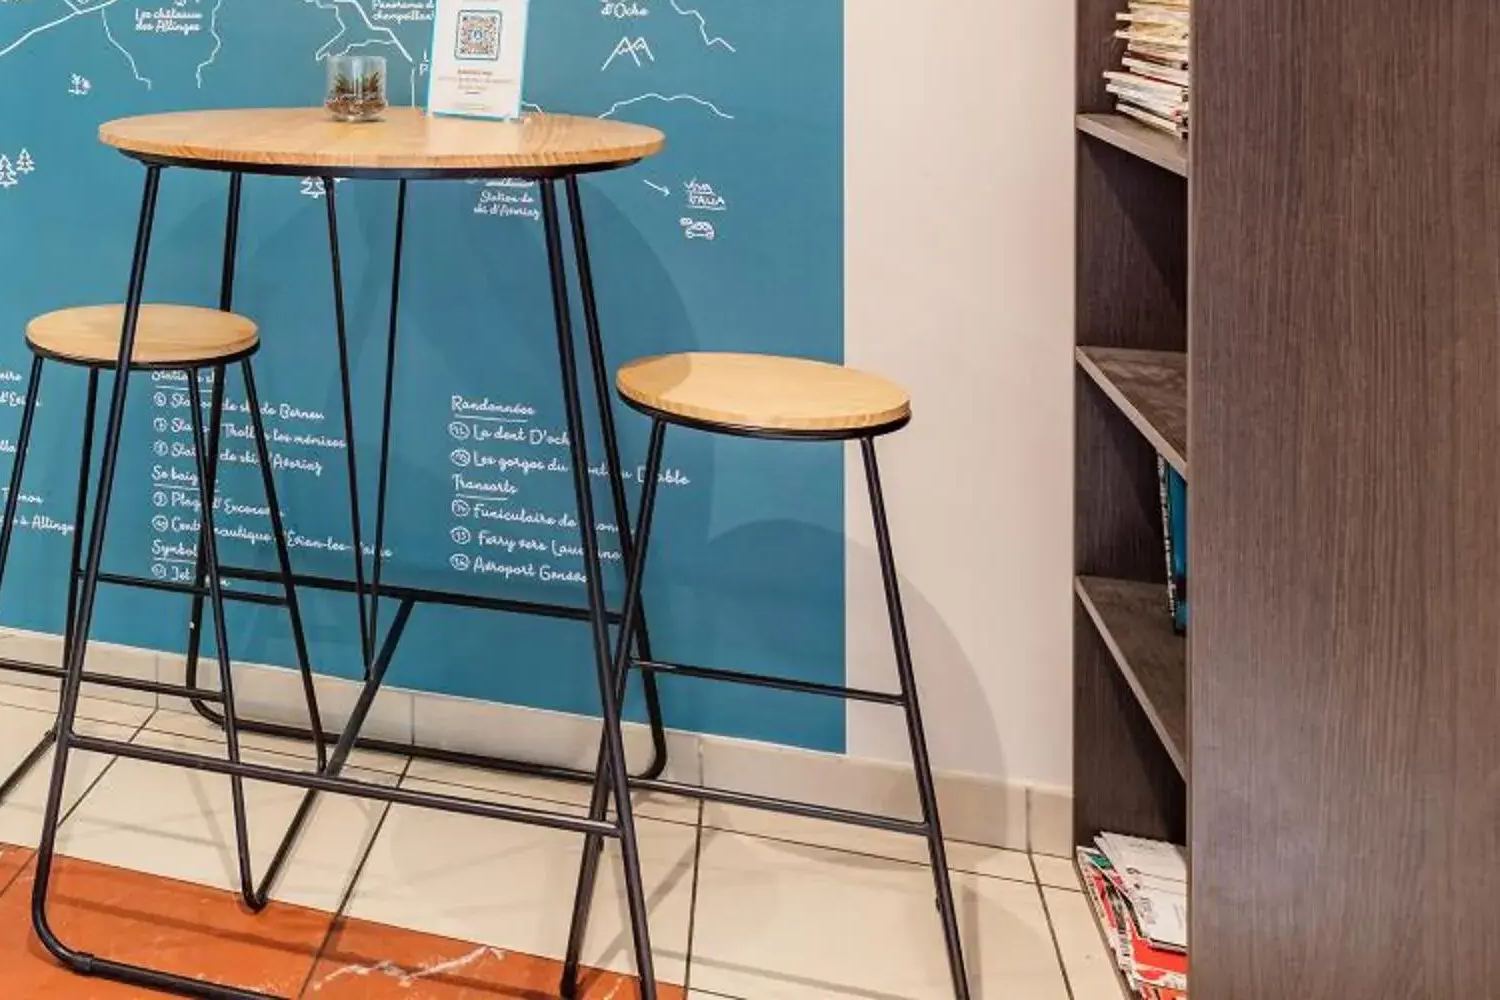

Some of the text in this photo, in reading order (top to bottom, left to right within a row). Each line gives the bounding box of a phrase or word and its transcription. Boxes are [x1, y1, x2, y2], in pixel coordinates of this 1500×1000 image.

[259, 401, 277, 415] de
[451, 395, 536, 415] Randonnées
[272, 427, 292, 442] les
[473, 424, 492, 441] La
[494, 425, 527, 441] dent
[529, 428, 570, 446] D'och
[220, 448, 237, 462] de
[473, 450, 497, 467] Les
[499, 458, 545, 476] gorges
[547, 458, 569, 473] du
[151, 465, 169, 480] Se
[171, 491, 202, 511] Plag
[473, 503, 556, 527] Funiculaire
[558, 512, 577, 528] de
[477, 530, 516, 552] Ferry
[518, 537, 548, 551] vers
[473, 556, 536, 578] Aéroport
